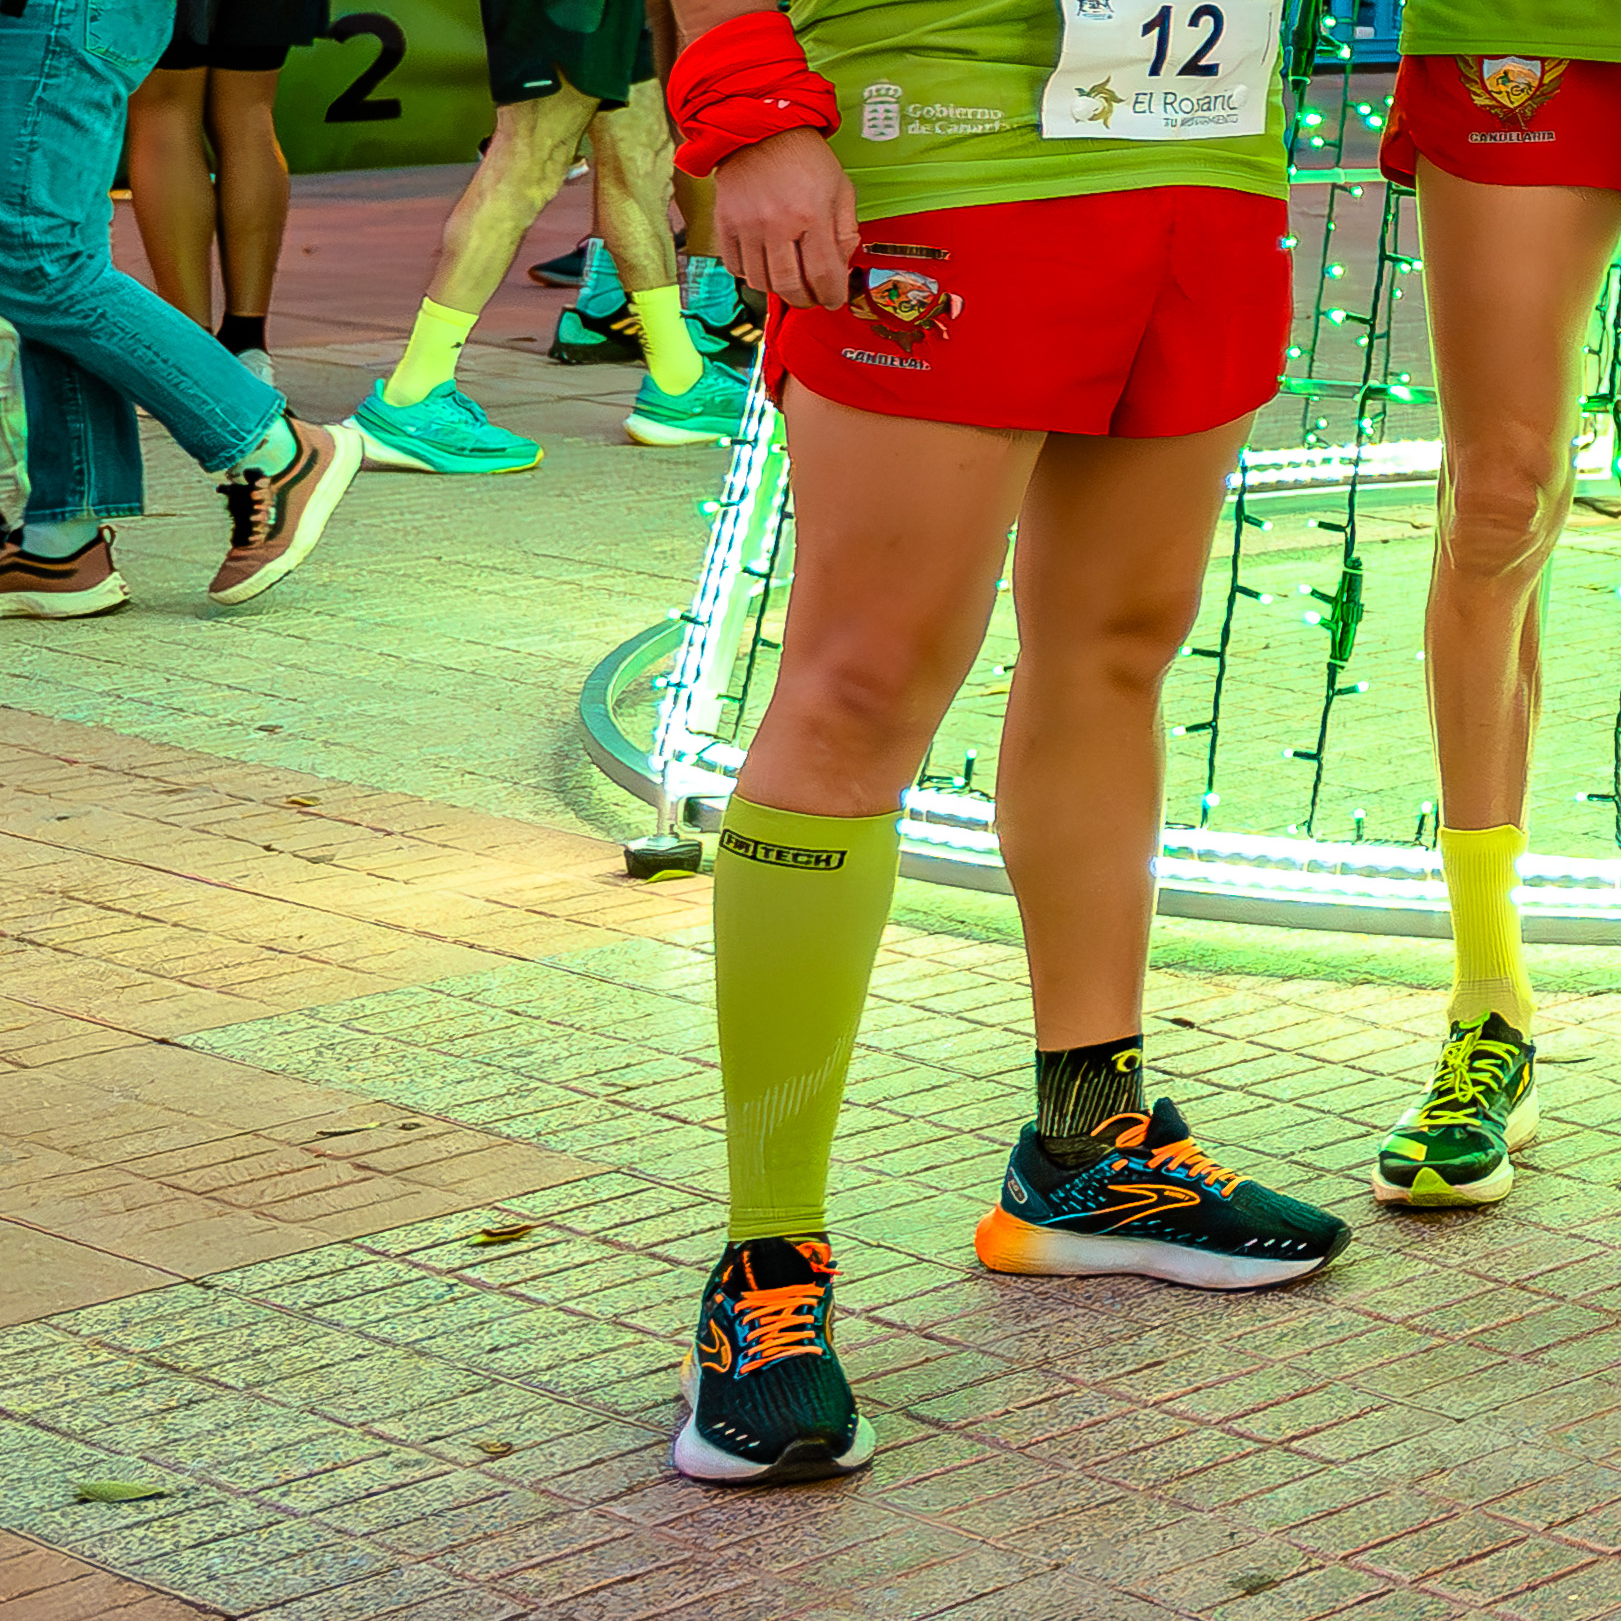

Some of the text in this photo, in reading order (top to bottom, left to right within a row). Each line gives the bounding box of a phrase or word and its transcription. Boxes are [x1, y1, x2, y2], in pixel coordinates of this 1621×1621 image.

[1141, 4, 1224, 77] 12
[325, 12, 407, 123] 2
[1133, 93, 1153, 114] El
[1164, 118, 1177, 127] TU
[760, 846, 833, 867] TECH
